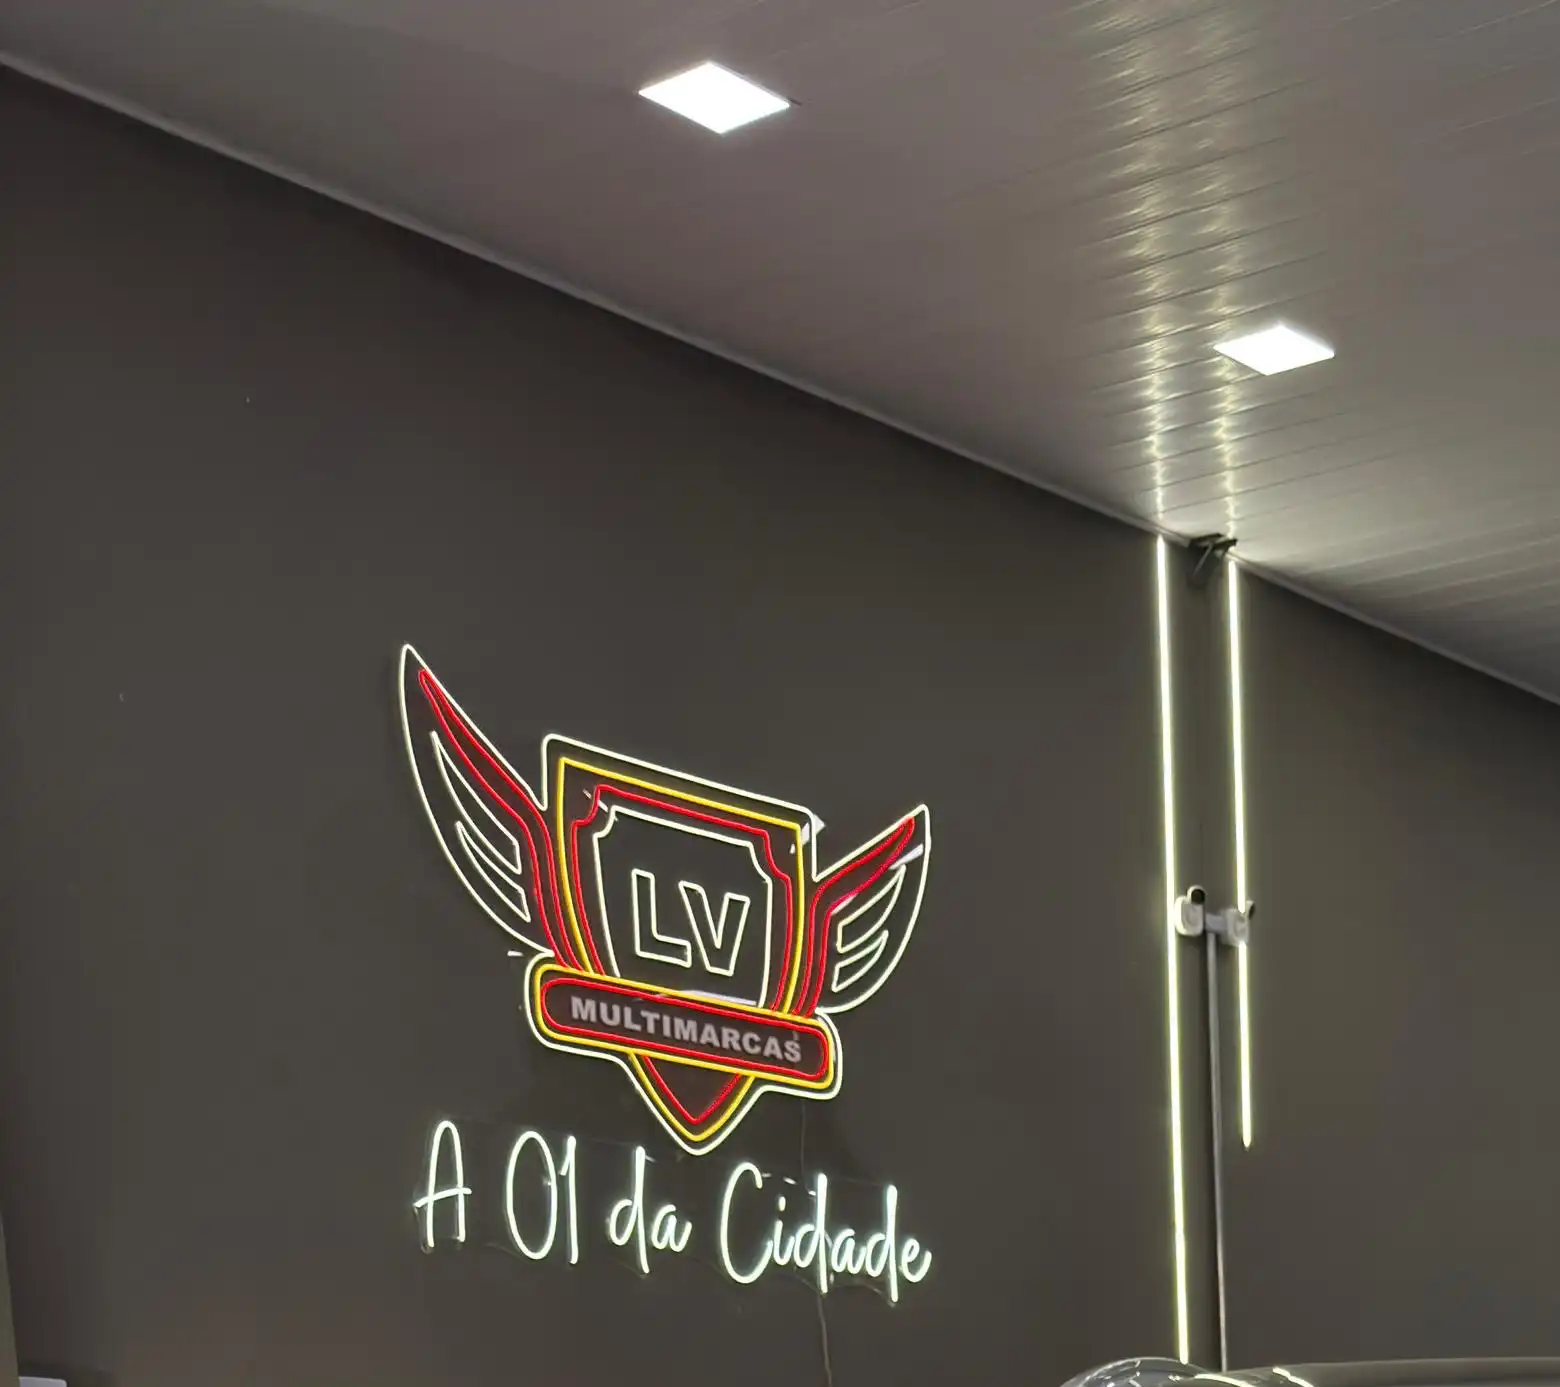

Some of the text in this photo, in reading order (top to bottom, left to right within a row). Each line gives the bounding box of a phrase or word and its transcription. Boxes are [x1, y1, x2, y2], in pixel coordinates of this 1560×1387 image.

[632, 868, 751, 977] LV
[571, 996, 802, 1064] MULTIMARCAS
[413, 1120, 933, 1303] A 01 da Cidade
